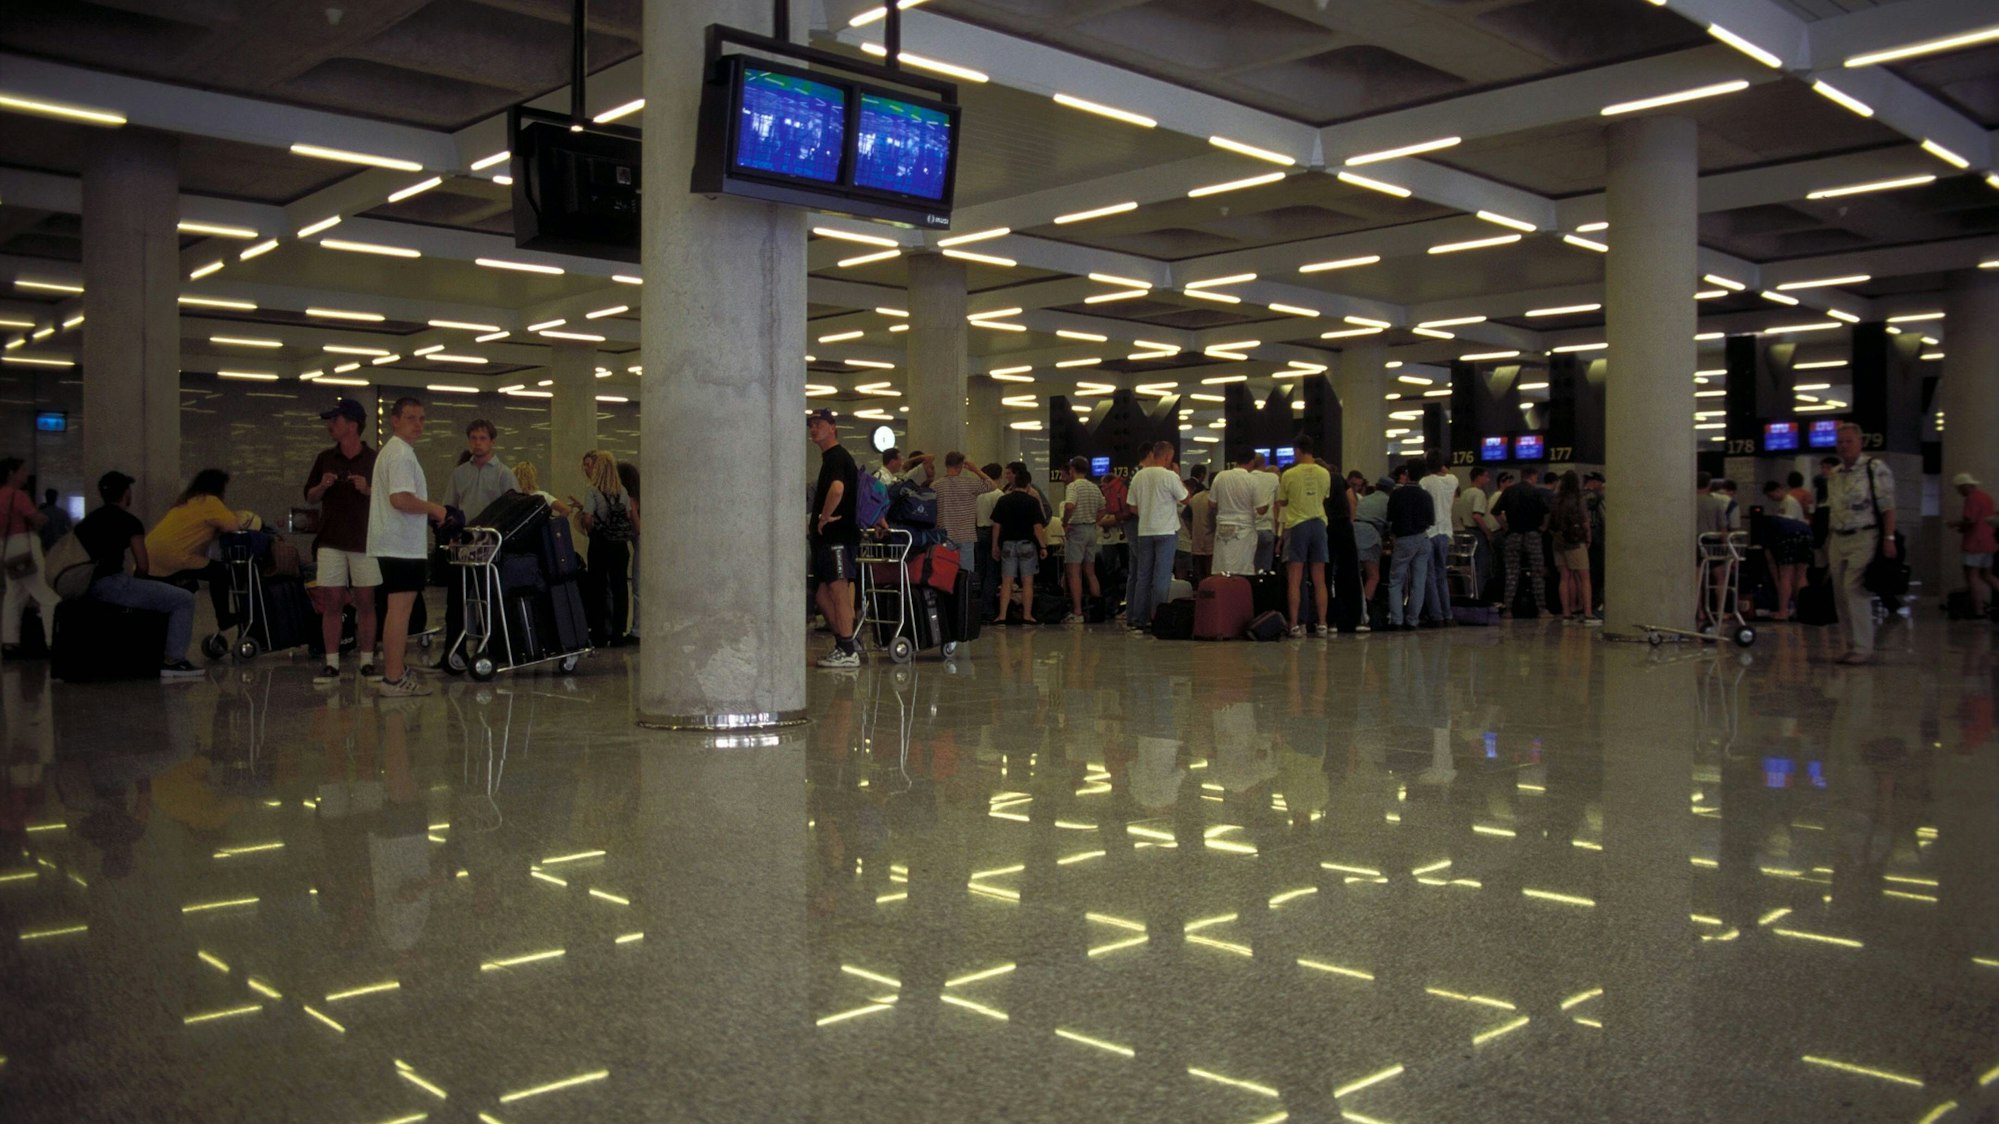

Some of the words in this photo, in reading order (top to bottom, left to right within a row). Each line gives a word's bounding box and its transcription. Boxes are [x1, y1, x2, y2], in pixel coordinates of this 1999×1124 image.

[1727, 440, 1755, 454] 178
[1863, 433, 1883, 448] 79
[1453, 451, 1475, 464] 176
[1550, 447, 1572, 461] 177
[1113, 467, 1129, 477] 173
